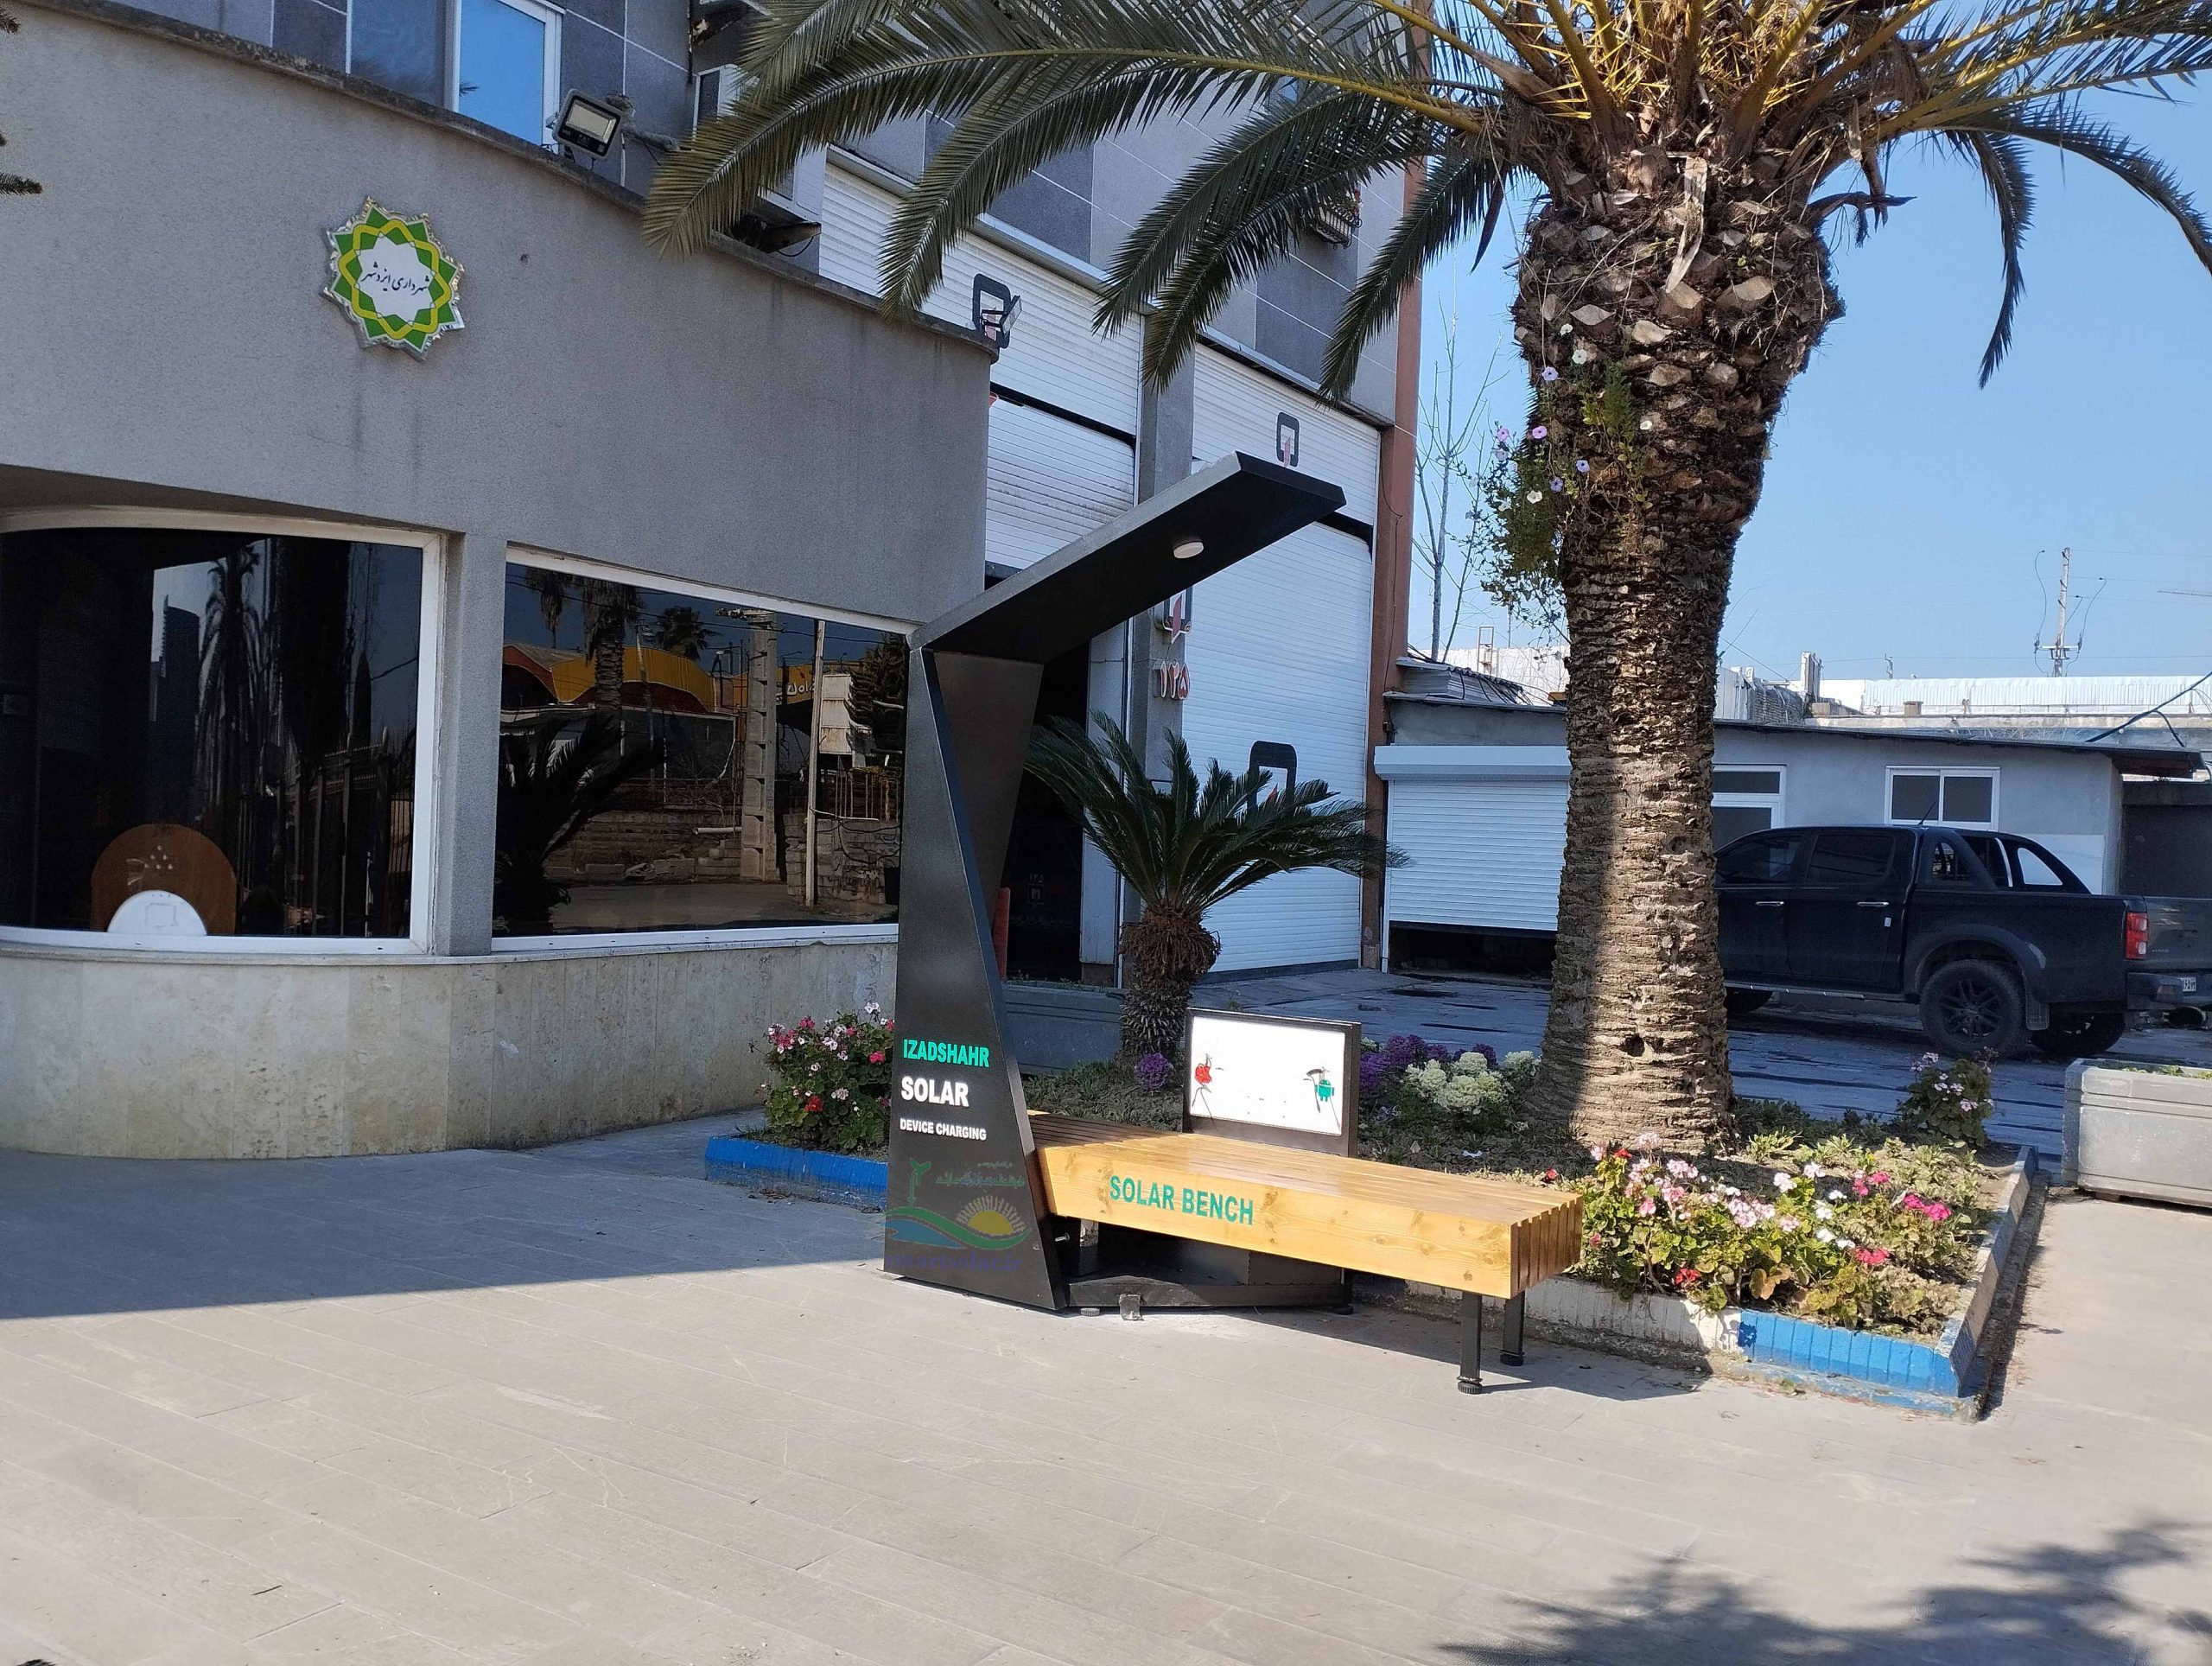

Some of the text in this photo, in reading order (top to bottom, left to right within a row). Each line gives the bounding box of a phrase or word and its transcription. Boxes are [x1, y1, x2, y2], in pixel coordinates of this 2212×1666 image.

[360, 261, 429, 296] شهرداری ایزدشهر
[903, 1039, 989, 1067] IZADSHAHR
[900, 1076, 969, 1107] SOLAR
[899, 1117, 987, 1141] DEVICE CHARGING
[1109, 1175, 1254, 1225] SOLAR BENCH
